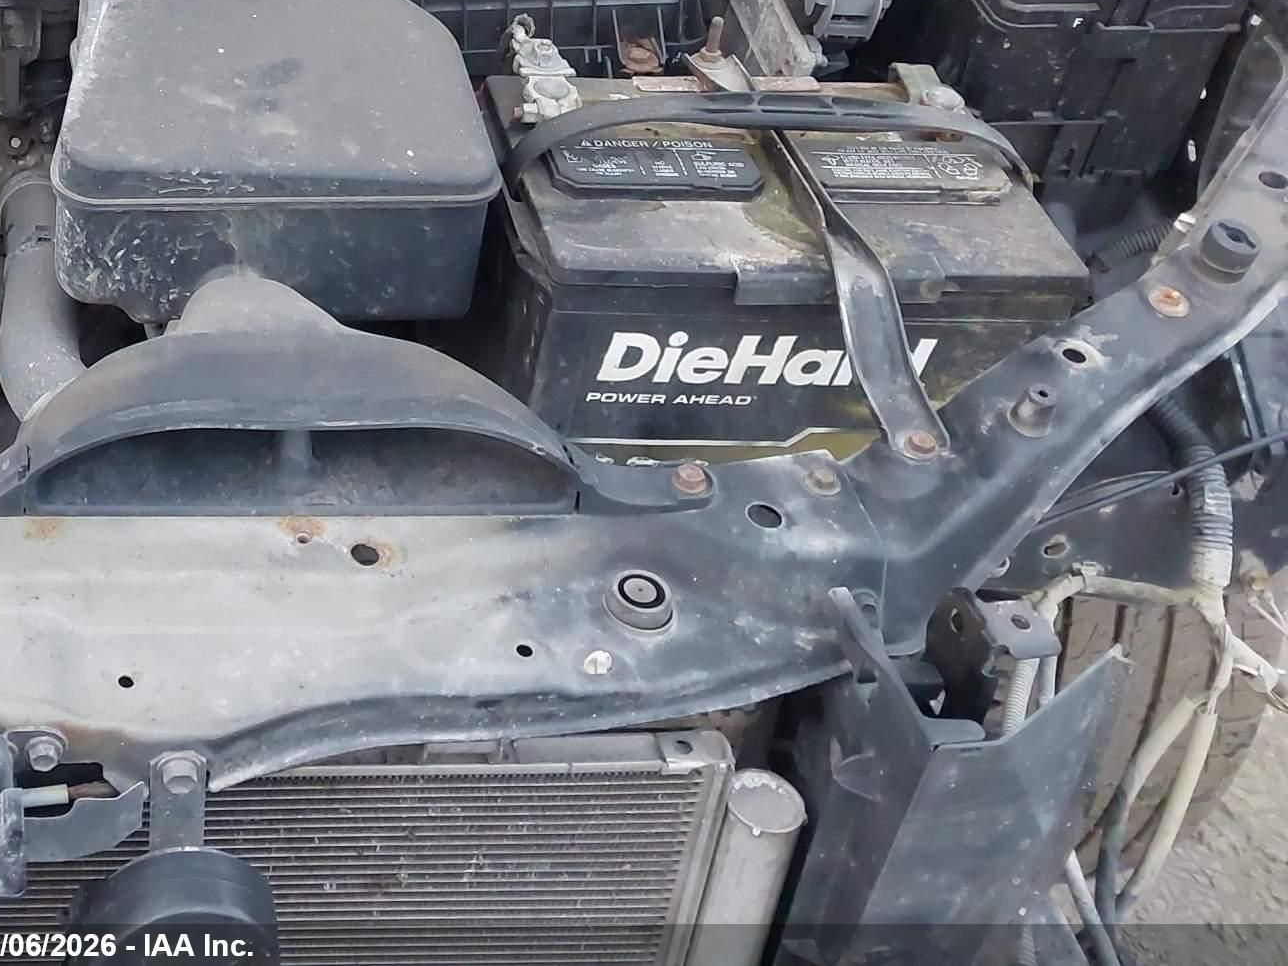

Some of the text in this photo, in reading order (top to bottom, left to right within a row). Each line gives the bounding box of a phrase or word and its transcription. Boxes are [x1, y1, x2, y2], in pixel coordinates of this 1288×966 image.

[593, 139, 649, 149] DANGER
[662, 140, 712, 149] POISON
[585, 391, 753, 406] POWER AHEAD
